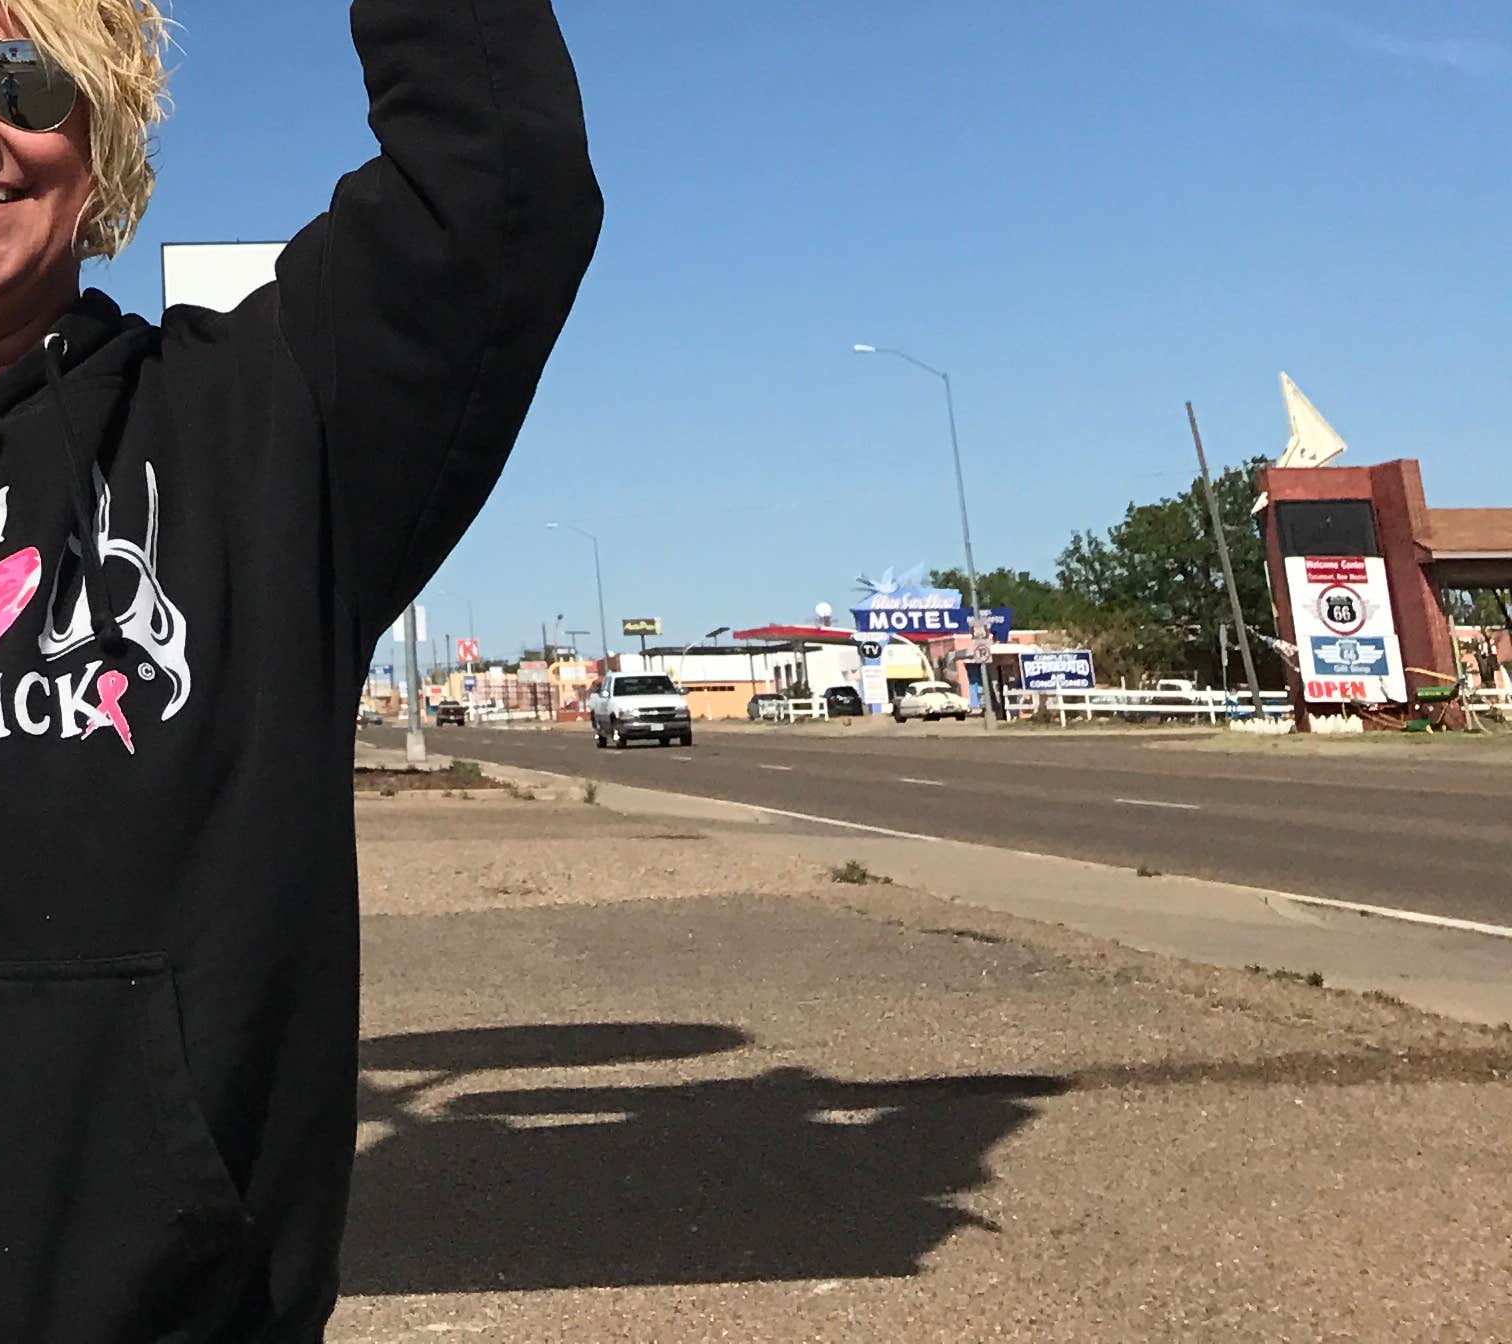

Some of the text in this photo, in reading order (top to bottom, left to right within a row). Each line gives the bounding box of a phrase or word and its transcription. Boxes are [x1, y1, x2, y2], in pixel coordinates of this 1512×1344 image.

[1307, 560, 1364, 569] Welcome Center
[869, 611, 959, 630] MOTEL
[1333, 605, 1351, 621] 66
[863, 644, 879, 655] TV
[1024, 659, 1090, 677] REFRIGERATED
[1307, 680, 1367, 699] OPEN
